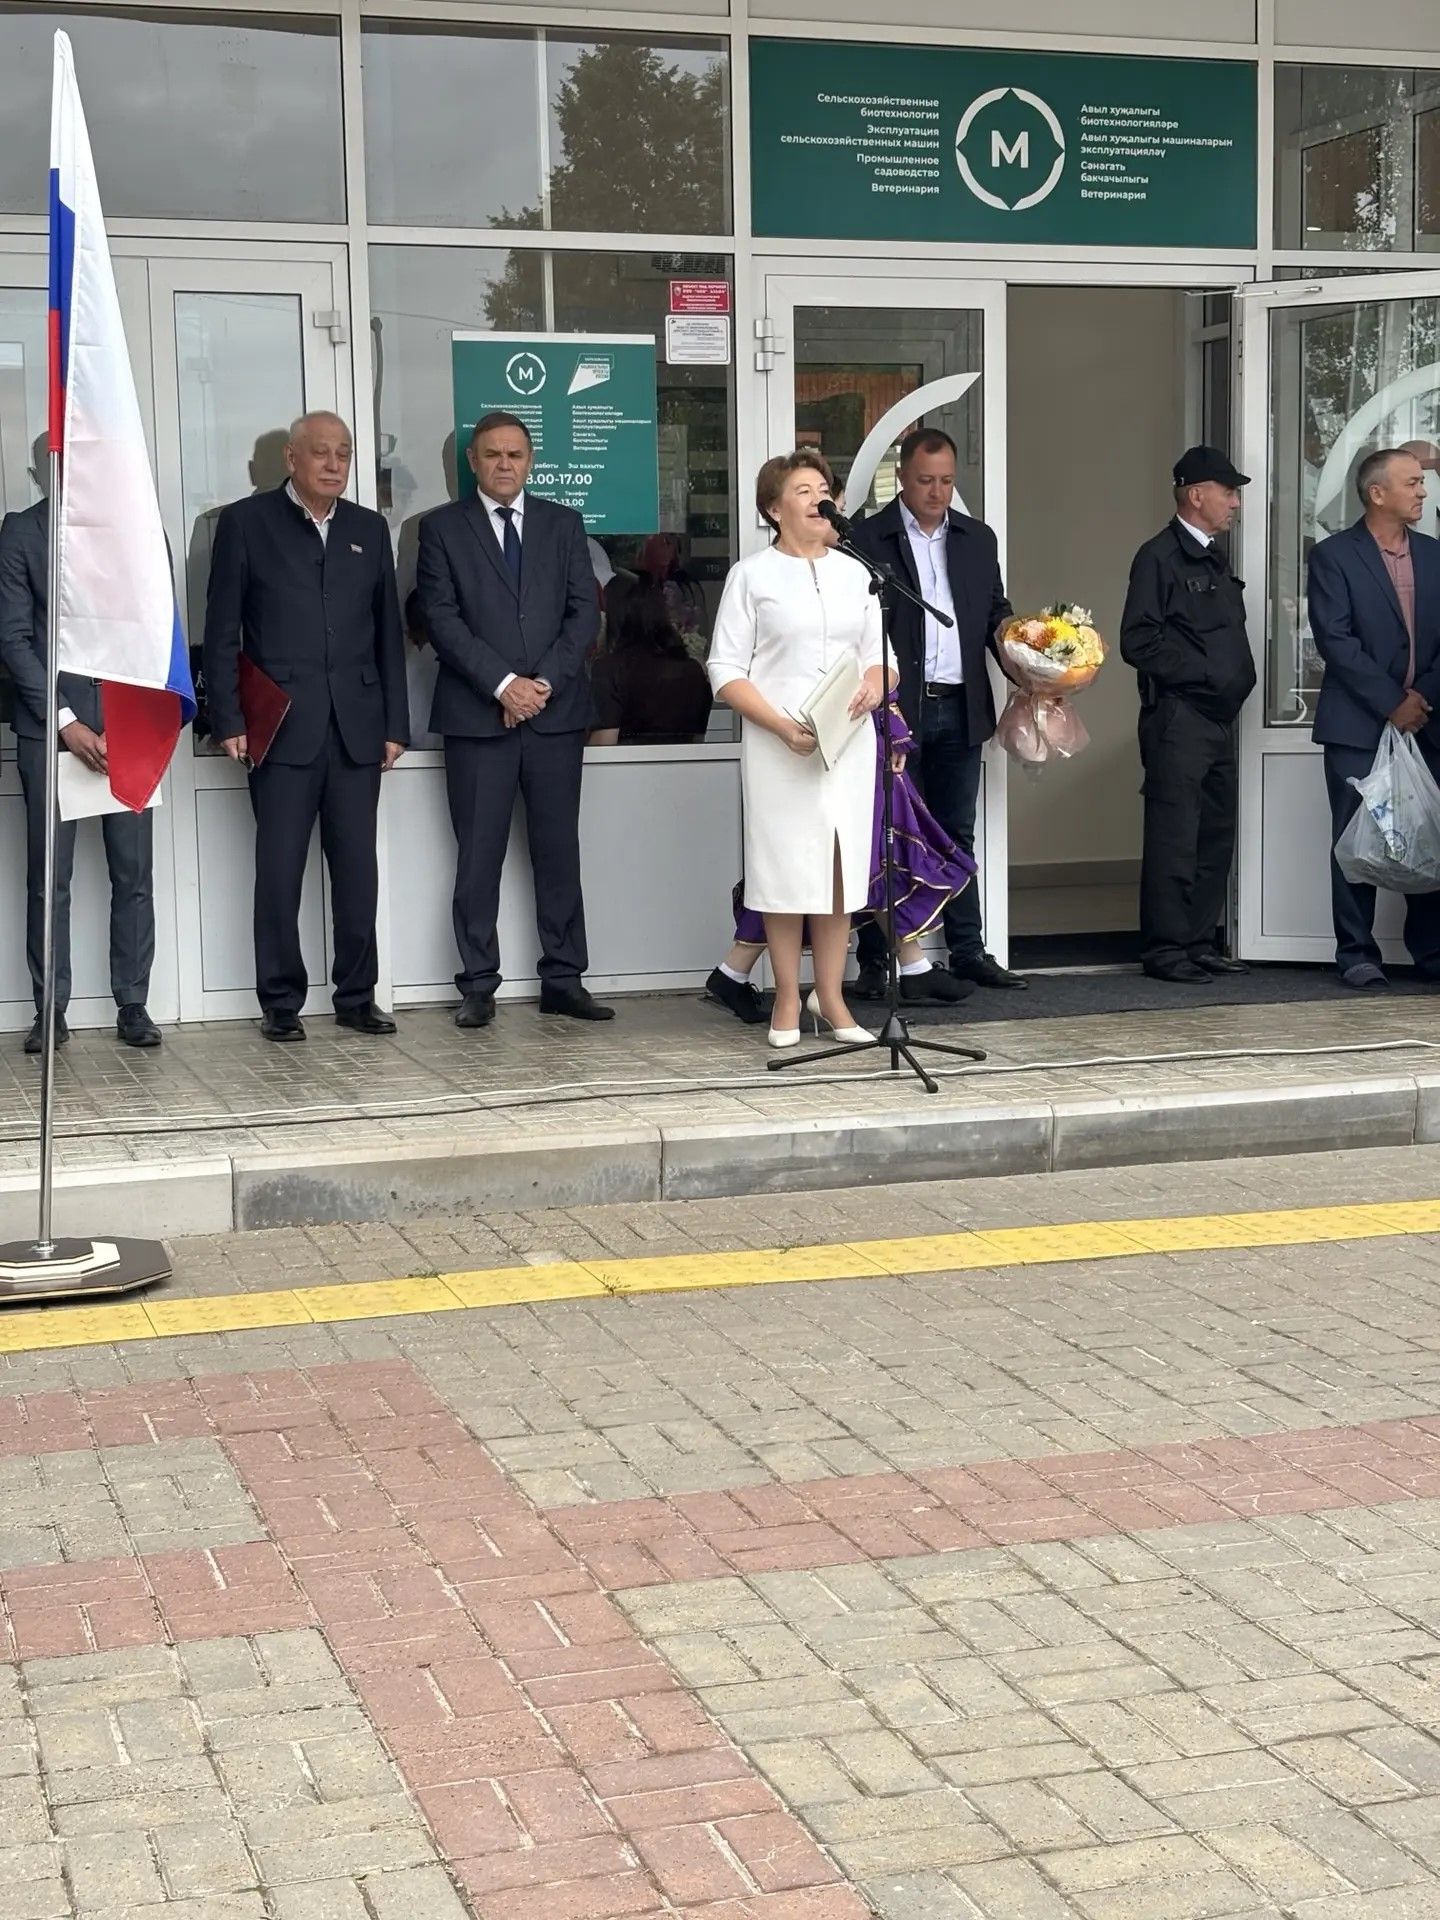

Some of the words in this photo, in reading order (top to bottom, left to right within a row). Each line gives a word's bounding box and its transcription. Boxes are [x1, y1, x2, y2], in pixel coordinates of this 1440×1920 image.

[817, 93, 939, 107] Сельскохозяйственные
[860, 107, 940, 119] биотехнологии
[1080, 104, 1108, 114] Авыл
[867, 124, 940, 137] Эксплуатация
[780, 134, 901, 147] сельскохозяйственных
[903, 139, 940, 148] машин
[1080, 132, 1108, 142] Авыл
[1162, 137, 1233, 148] машиналарын
[856, 153, 940, 165] Промышленное
[874, 167, 940, 178] садоводство
[1080, 172, 1149, 184] бакчачылыгы
[871, 183, 940, 195] Ветеринария
[1080, 189, 1147, 200] Ветеринария
